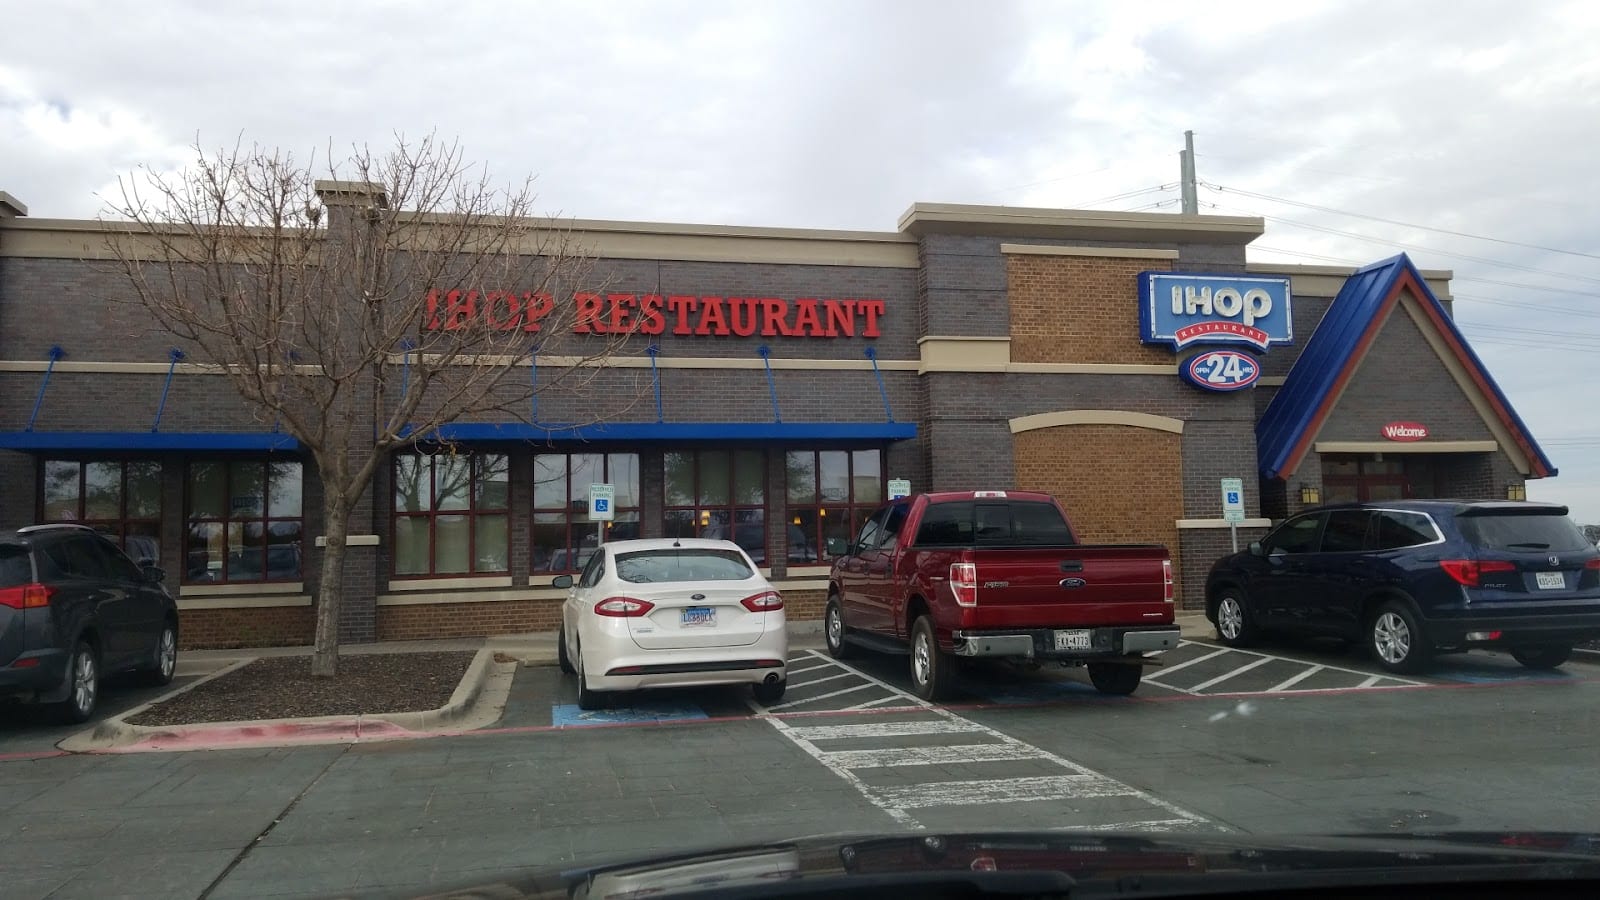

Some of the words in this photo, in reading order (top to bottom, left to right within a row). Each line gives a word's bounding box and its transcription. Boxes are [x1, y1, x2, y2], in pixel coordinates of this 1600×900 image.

[427, 288, 554, 333] IHOP
[573, 292, 885, 338] RESTAURANT
[1171, 285, 1272, 326] IHOP
[1180, 323, 1264, 340] RESTAURANT
[1195, 366, 1210, 374] OPEN
[1206, 353, 1244, 383] 24
[1242, 366, 1254, 374] HRS
[1384, 425, 1427, 438] Welcome
